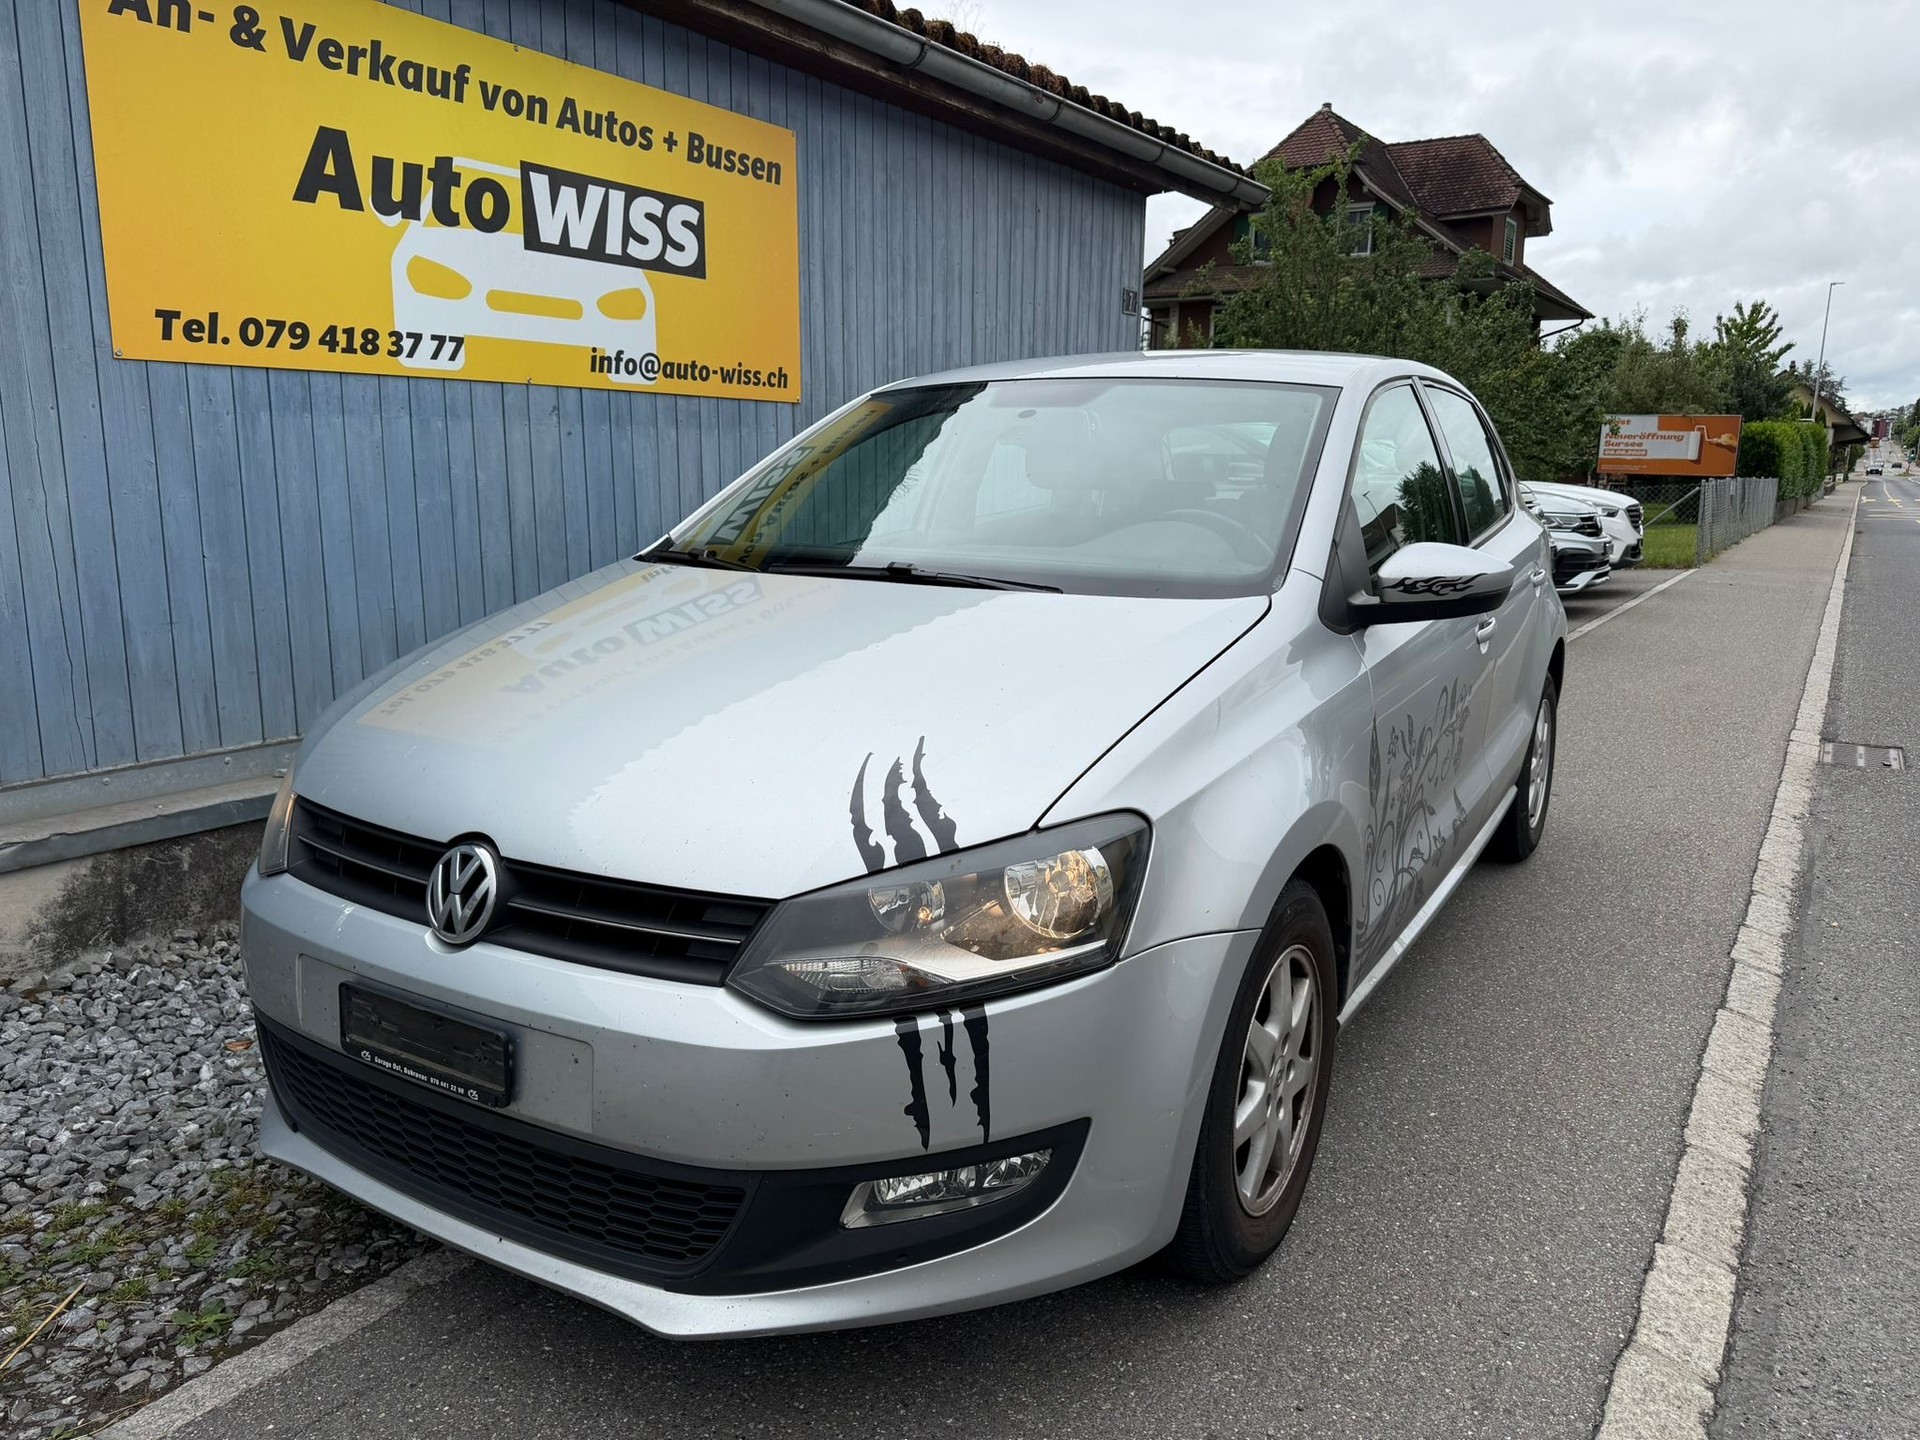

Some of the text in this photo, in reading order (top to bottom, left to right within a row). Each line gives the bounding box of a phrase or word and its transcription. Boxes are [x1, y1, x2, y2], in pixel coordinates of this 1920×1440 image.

[229, 5, 267, 53] &
[279, 15, 471, 103] Verkauf
[479, 80, 548, 125] von
[556, 97, 653, 151] Autos
[663, 131, 678, 152] +
[687, 131, 782, 186] Bussen
[292, 125, 701, 268] Auto WISS
[155, 308, 465, 362] Tel. 079 418 37 77
[590, 347, 788, 389] info@auto-wiss.ch
[1604, 433, 1684, 442] Neueröffnung
[374, 1056, 391, 1068] Garage
